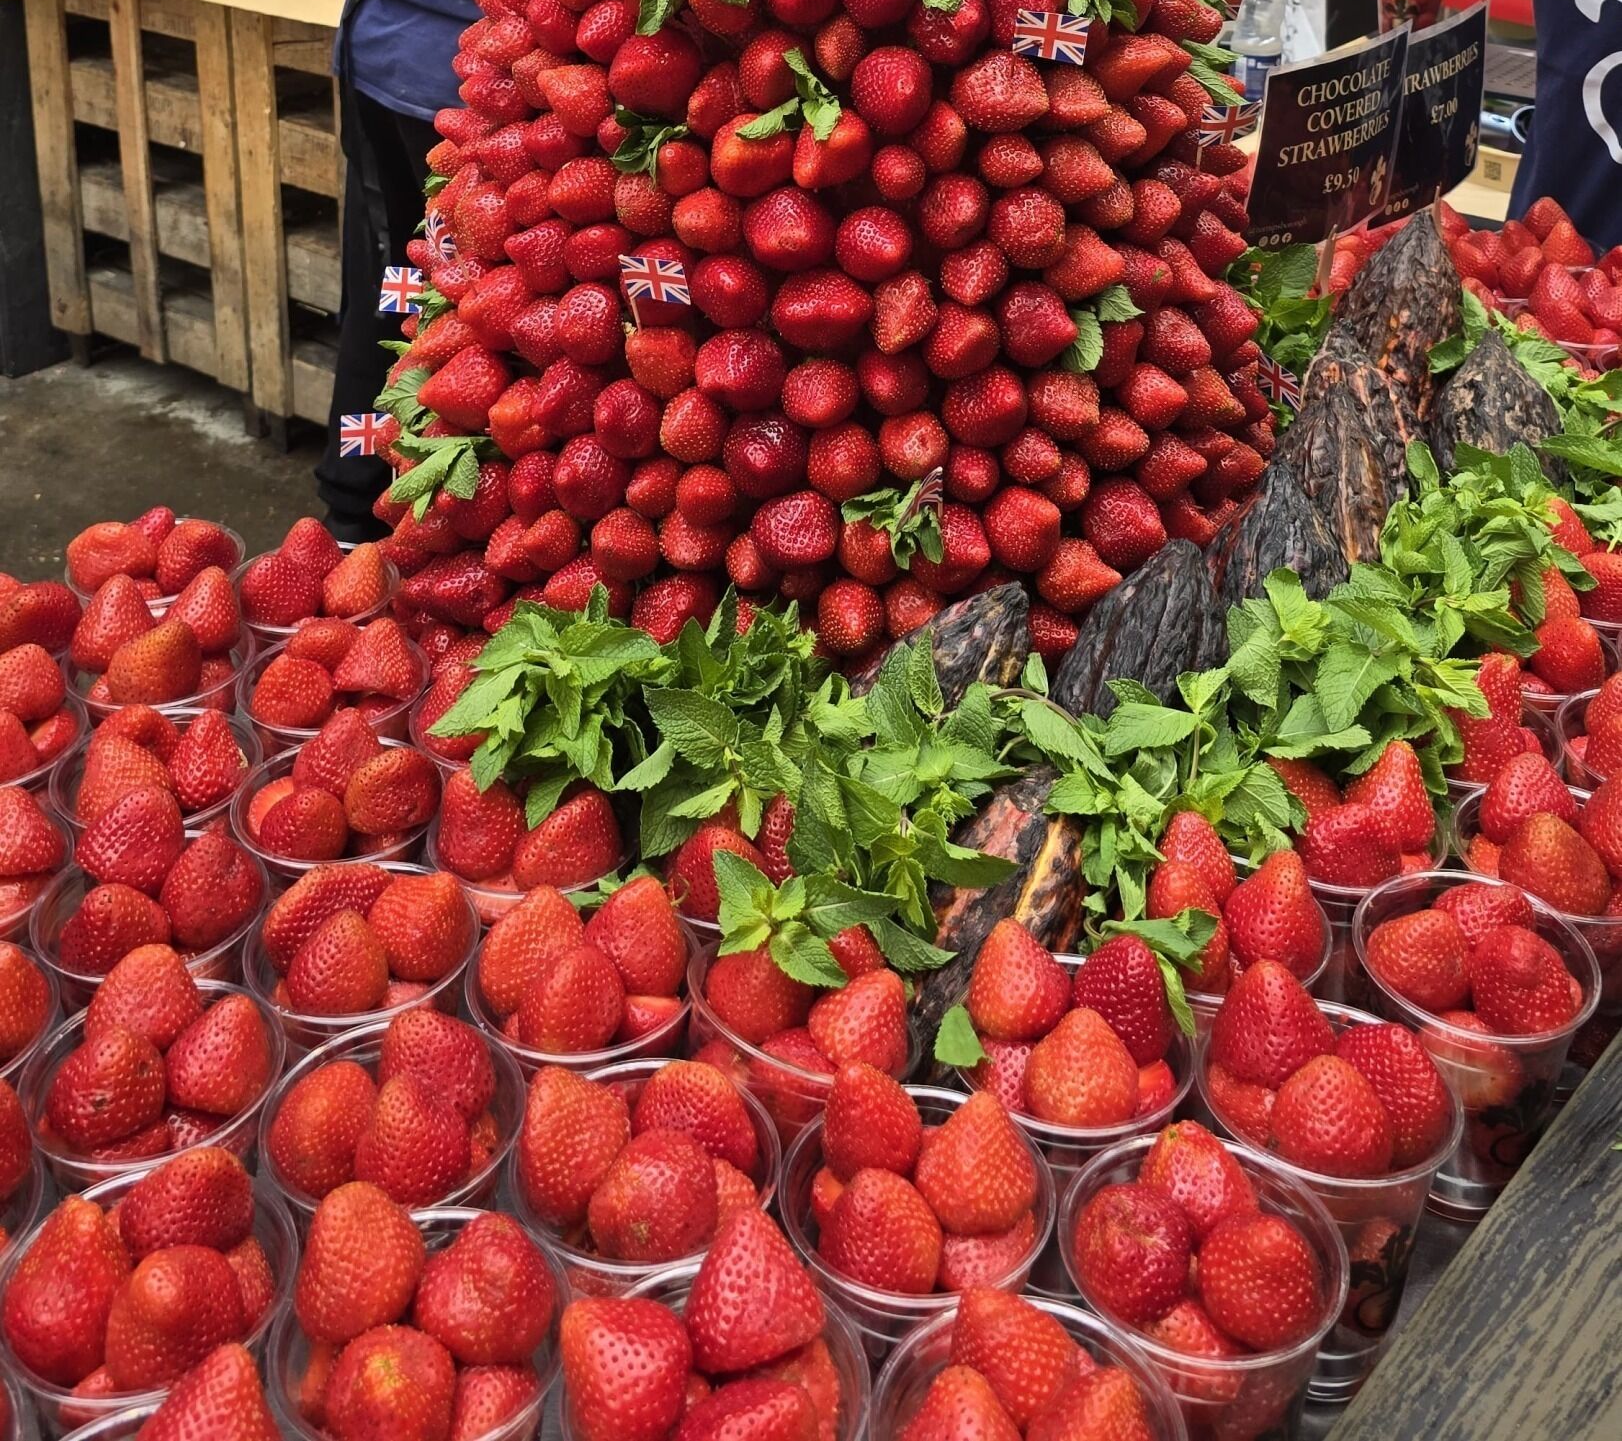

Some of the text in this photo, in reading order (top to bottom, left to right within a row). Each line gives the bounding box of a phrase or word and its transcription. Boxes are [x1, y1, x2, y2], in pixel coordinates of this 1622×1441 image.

[1297, 58, 1391, 107] CHOCOLATE
[1404, 41, 1479, 96] TRAWBERRIES
[1306, 90, 1381, 133] COVERED
[1430, 97, 1458, 125] £7.00
[1277, 110, 1390, 167] STRAWBERRIES
[1322, 166, 1360, 193] £9.50
